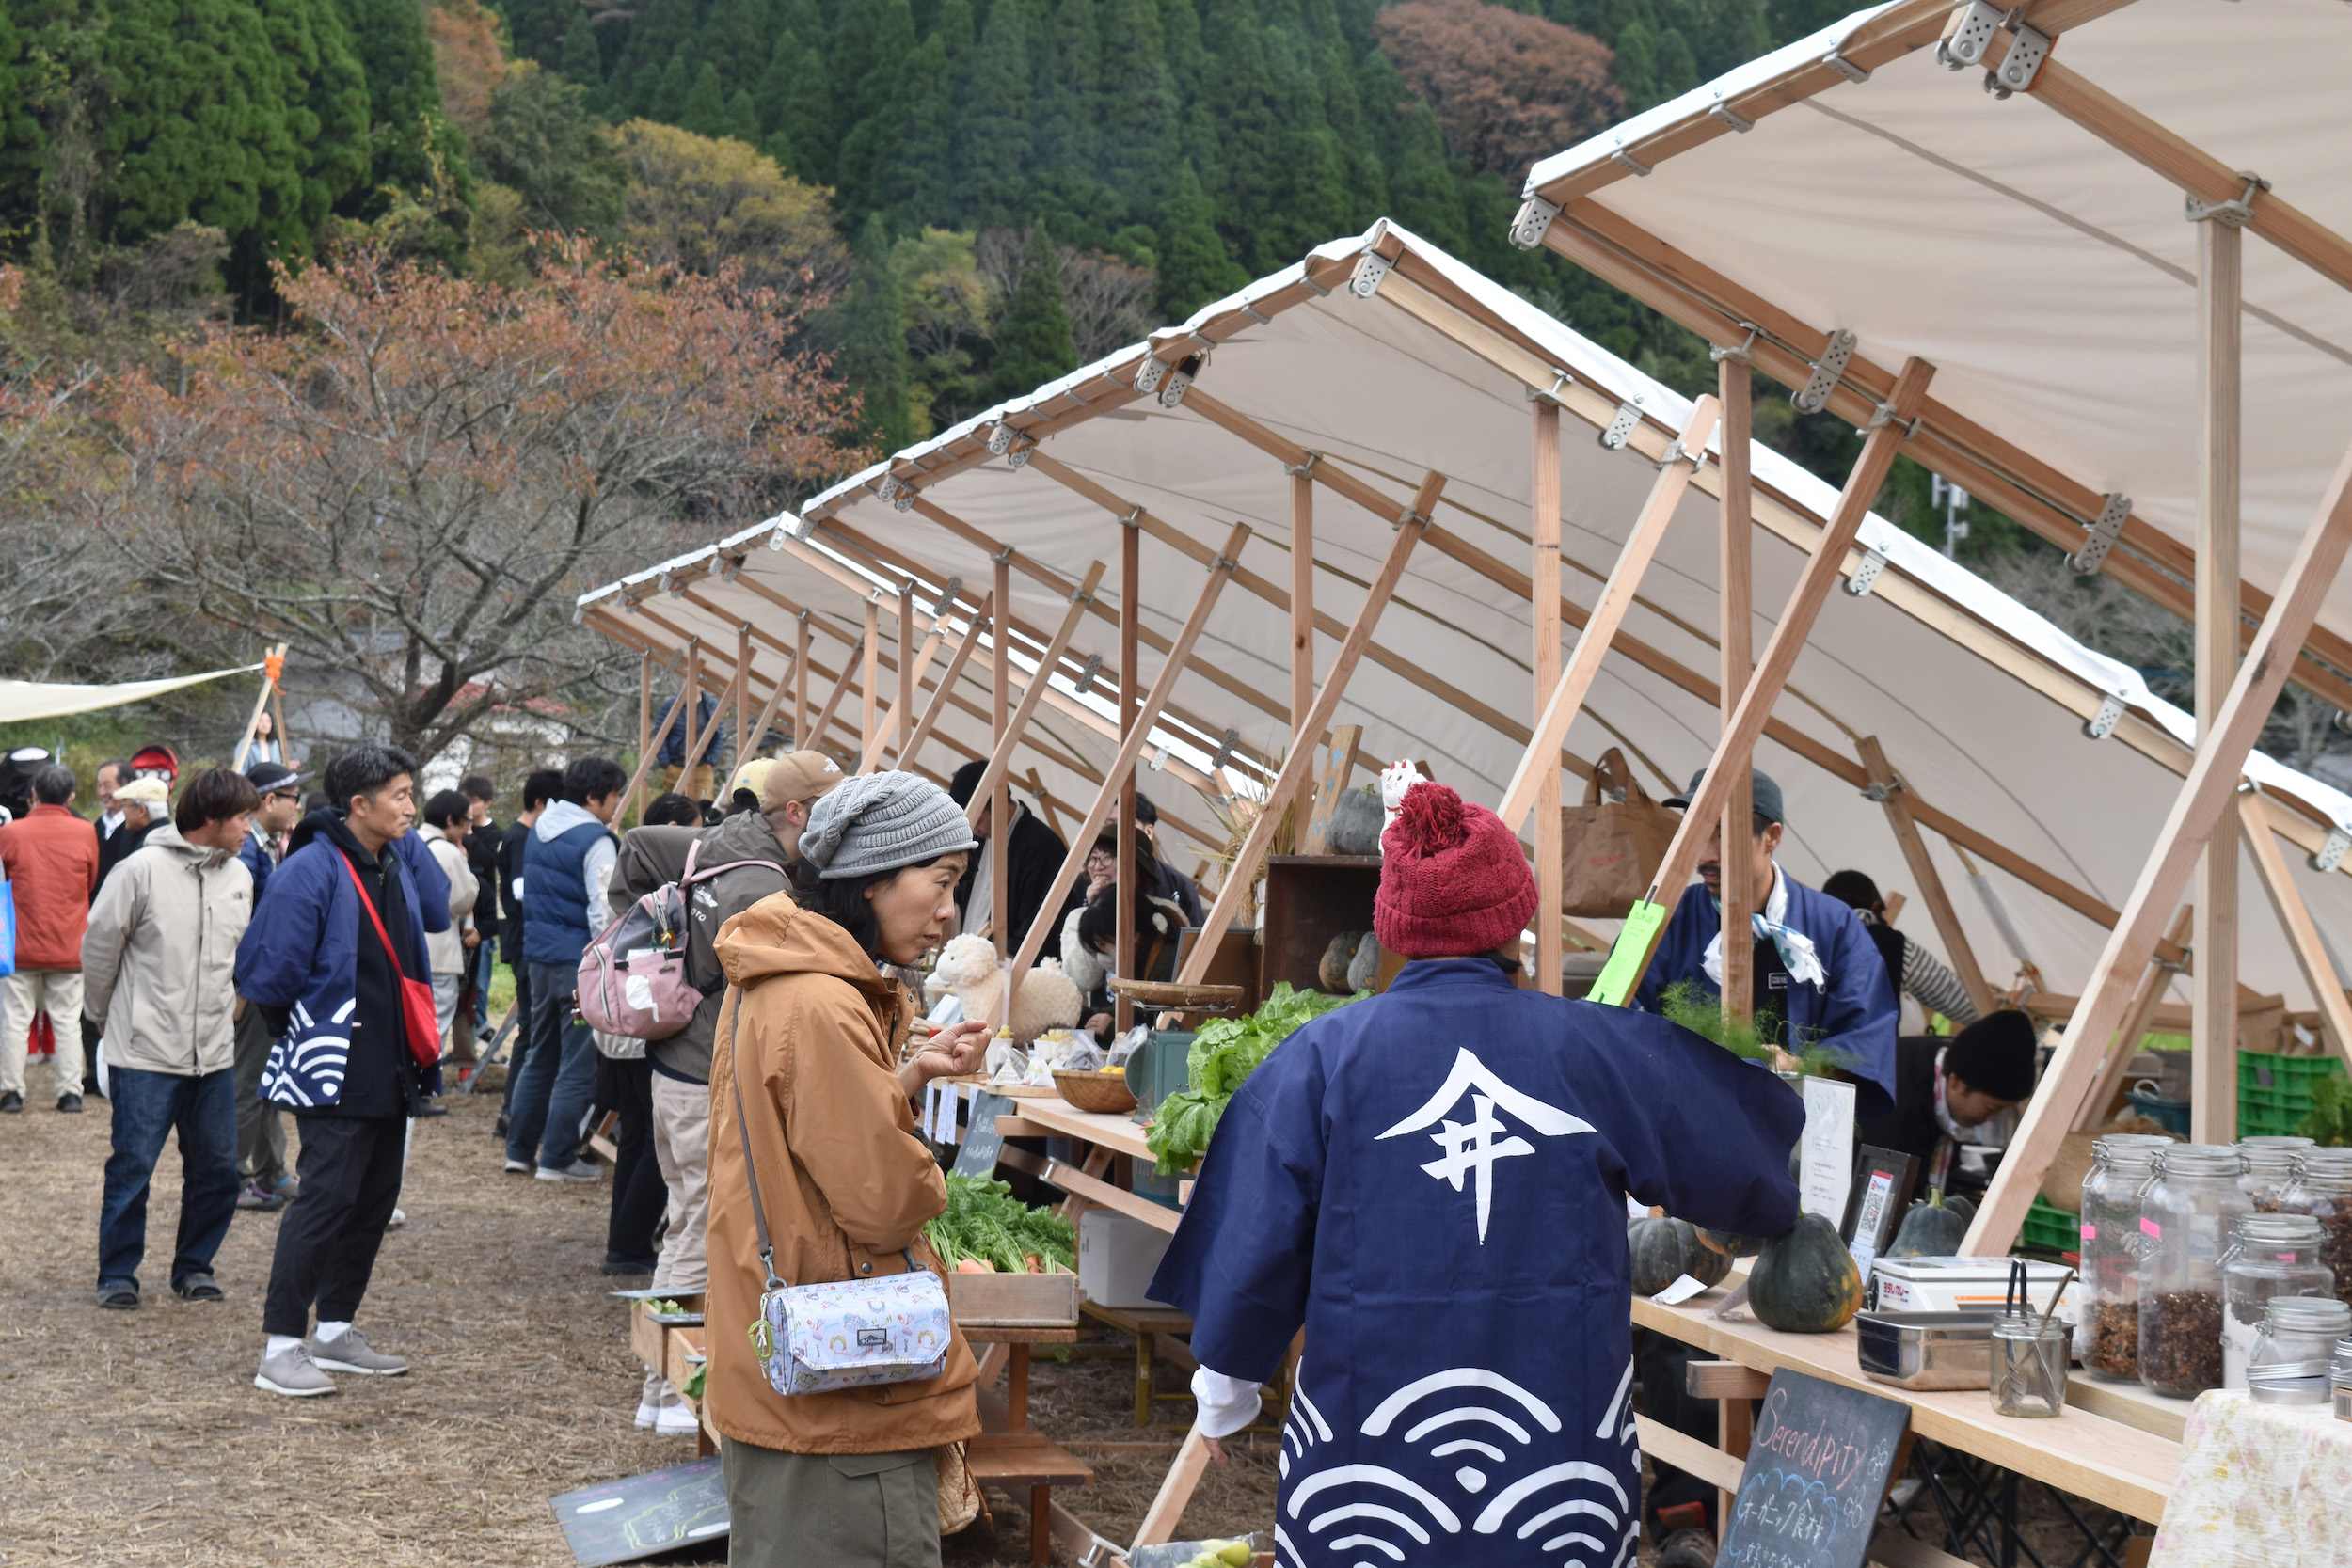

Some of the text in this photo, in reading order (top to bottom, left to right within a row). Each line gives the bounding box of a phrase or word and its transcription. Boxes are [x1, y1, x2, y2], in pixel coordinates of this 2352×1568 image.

[1756, 1387, 1869, 1491] Serendipity
[1742, 1492, 1825, 1545] オーガニック食材
